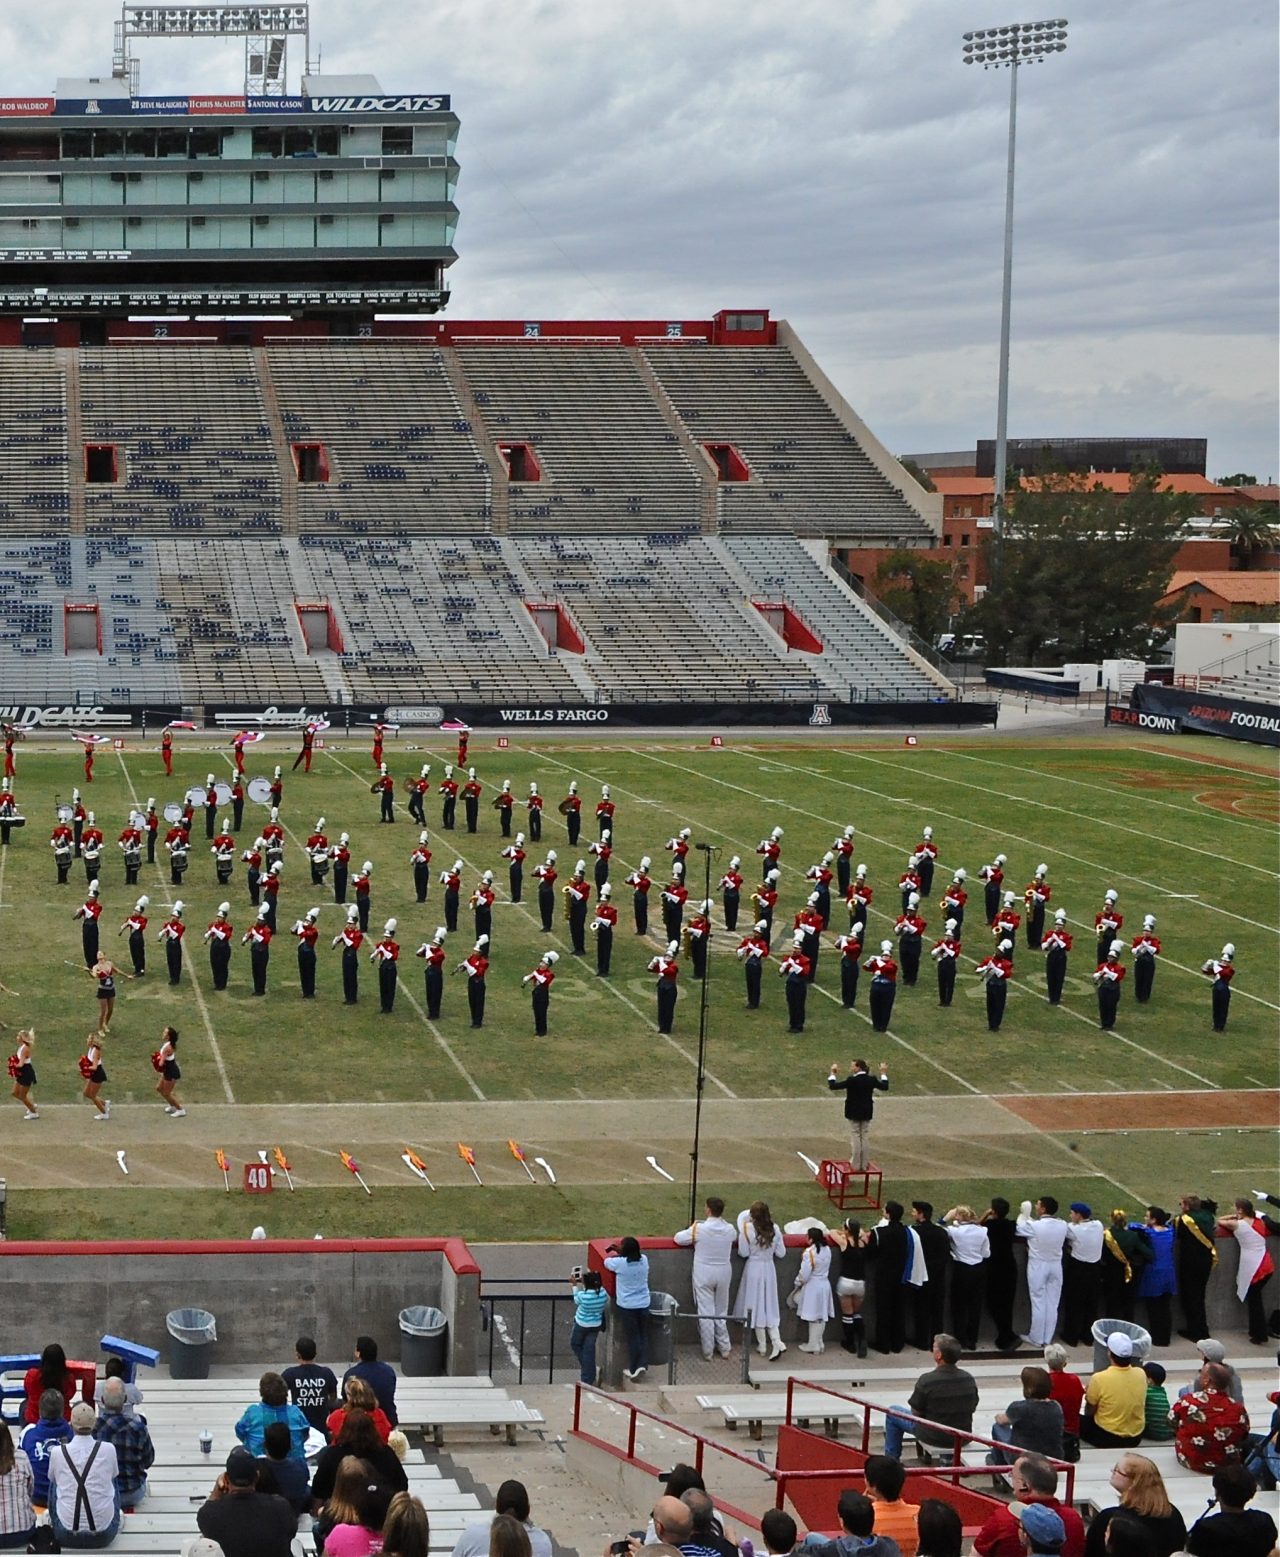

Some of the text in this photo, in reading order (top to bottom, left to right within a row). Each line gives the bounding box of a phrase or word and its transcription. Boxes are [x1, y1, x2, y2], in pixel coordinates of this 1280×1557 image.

[2, 102, 16, 111] ROB
[17, 102, 49, 111] WALDROP
[252, 100, 278, 109] ANTOINE
[279, 100, 302, 109] CASON
[310, 97, 443, 111] WILDCATS
[154, 328, 168, 337] 22
[525, 328, 538, 337] 24
[667, 328, 681, 337] 25
[500, 709, 608, 721] WELLS FARGO
[248, 1168, 267, 1188] 40
[295, 1378, 326, 1388] BAND
[299, 1388, 323, 1397] DAY
[296, 1397, 325, 1407] STAFF
